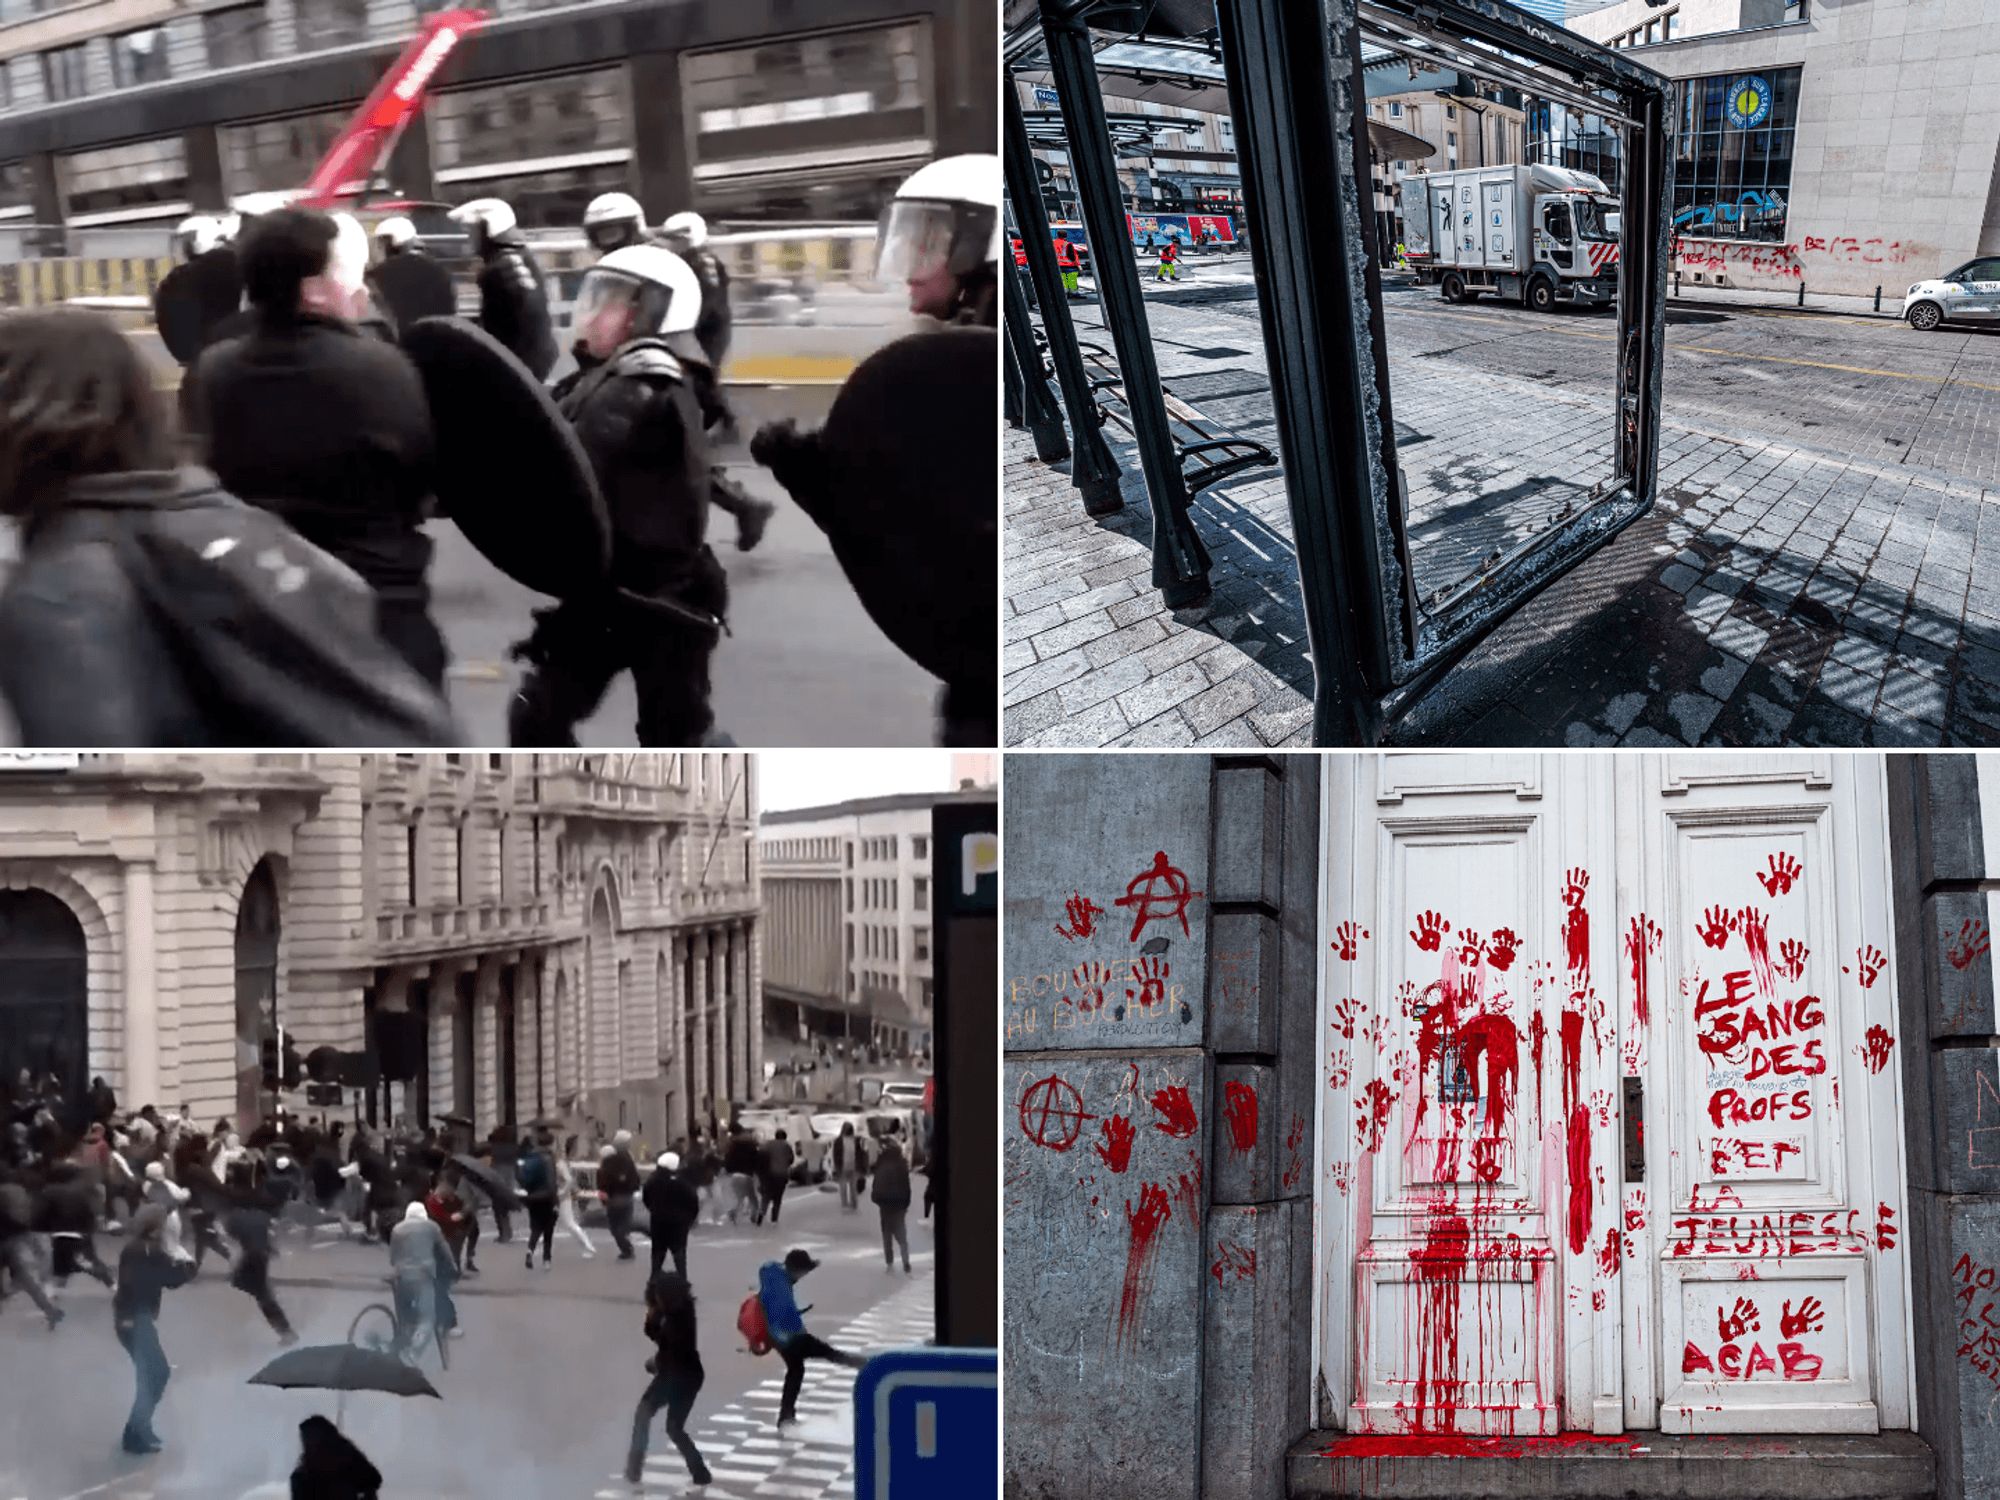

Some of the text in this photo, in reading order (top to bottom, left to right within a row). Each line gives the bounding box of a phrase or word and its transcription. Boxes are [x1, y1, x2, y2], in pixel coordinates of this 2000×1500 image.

[1695, 969, 1756, 1020] LE
[1007, 1007, 1037, 1039] AU
[1697, 996, 1826, 1053] SANG
[1745, 1040, 1827, 1081] DES
[1708, 1088, 1813, 1129] PROFS
[1688, 1183, 1744, 1213] LA
[1682, 1340, 1824, 1381] ACAB
